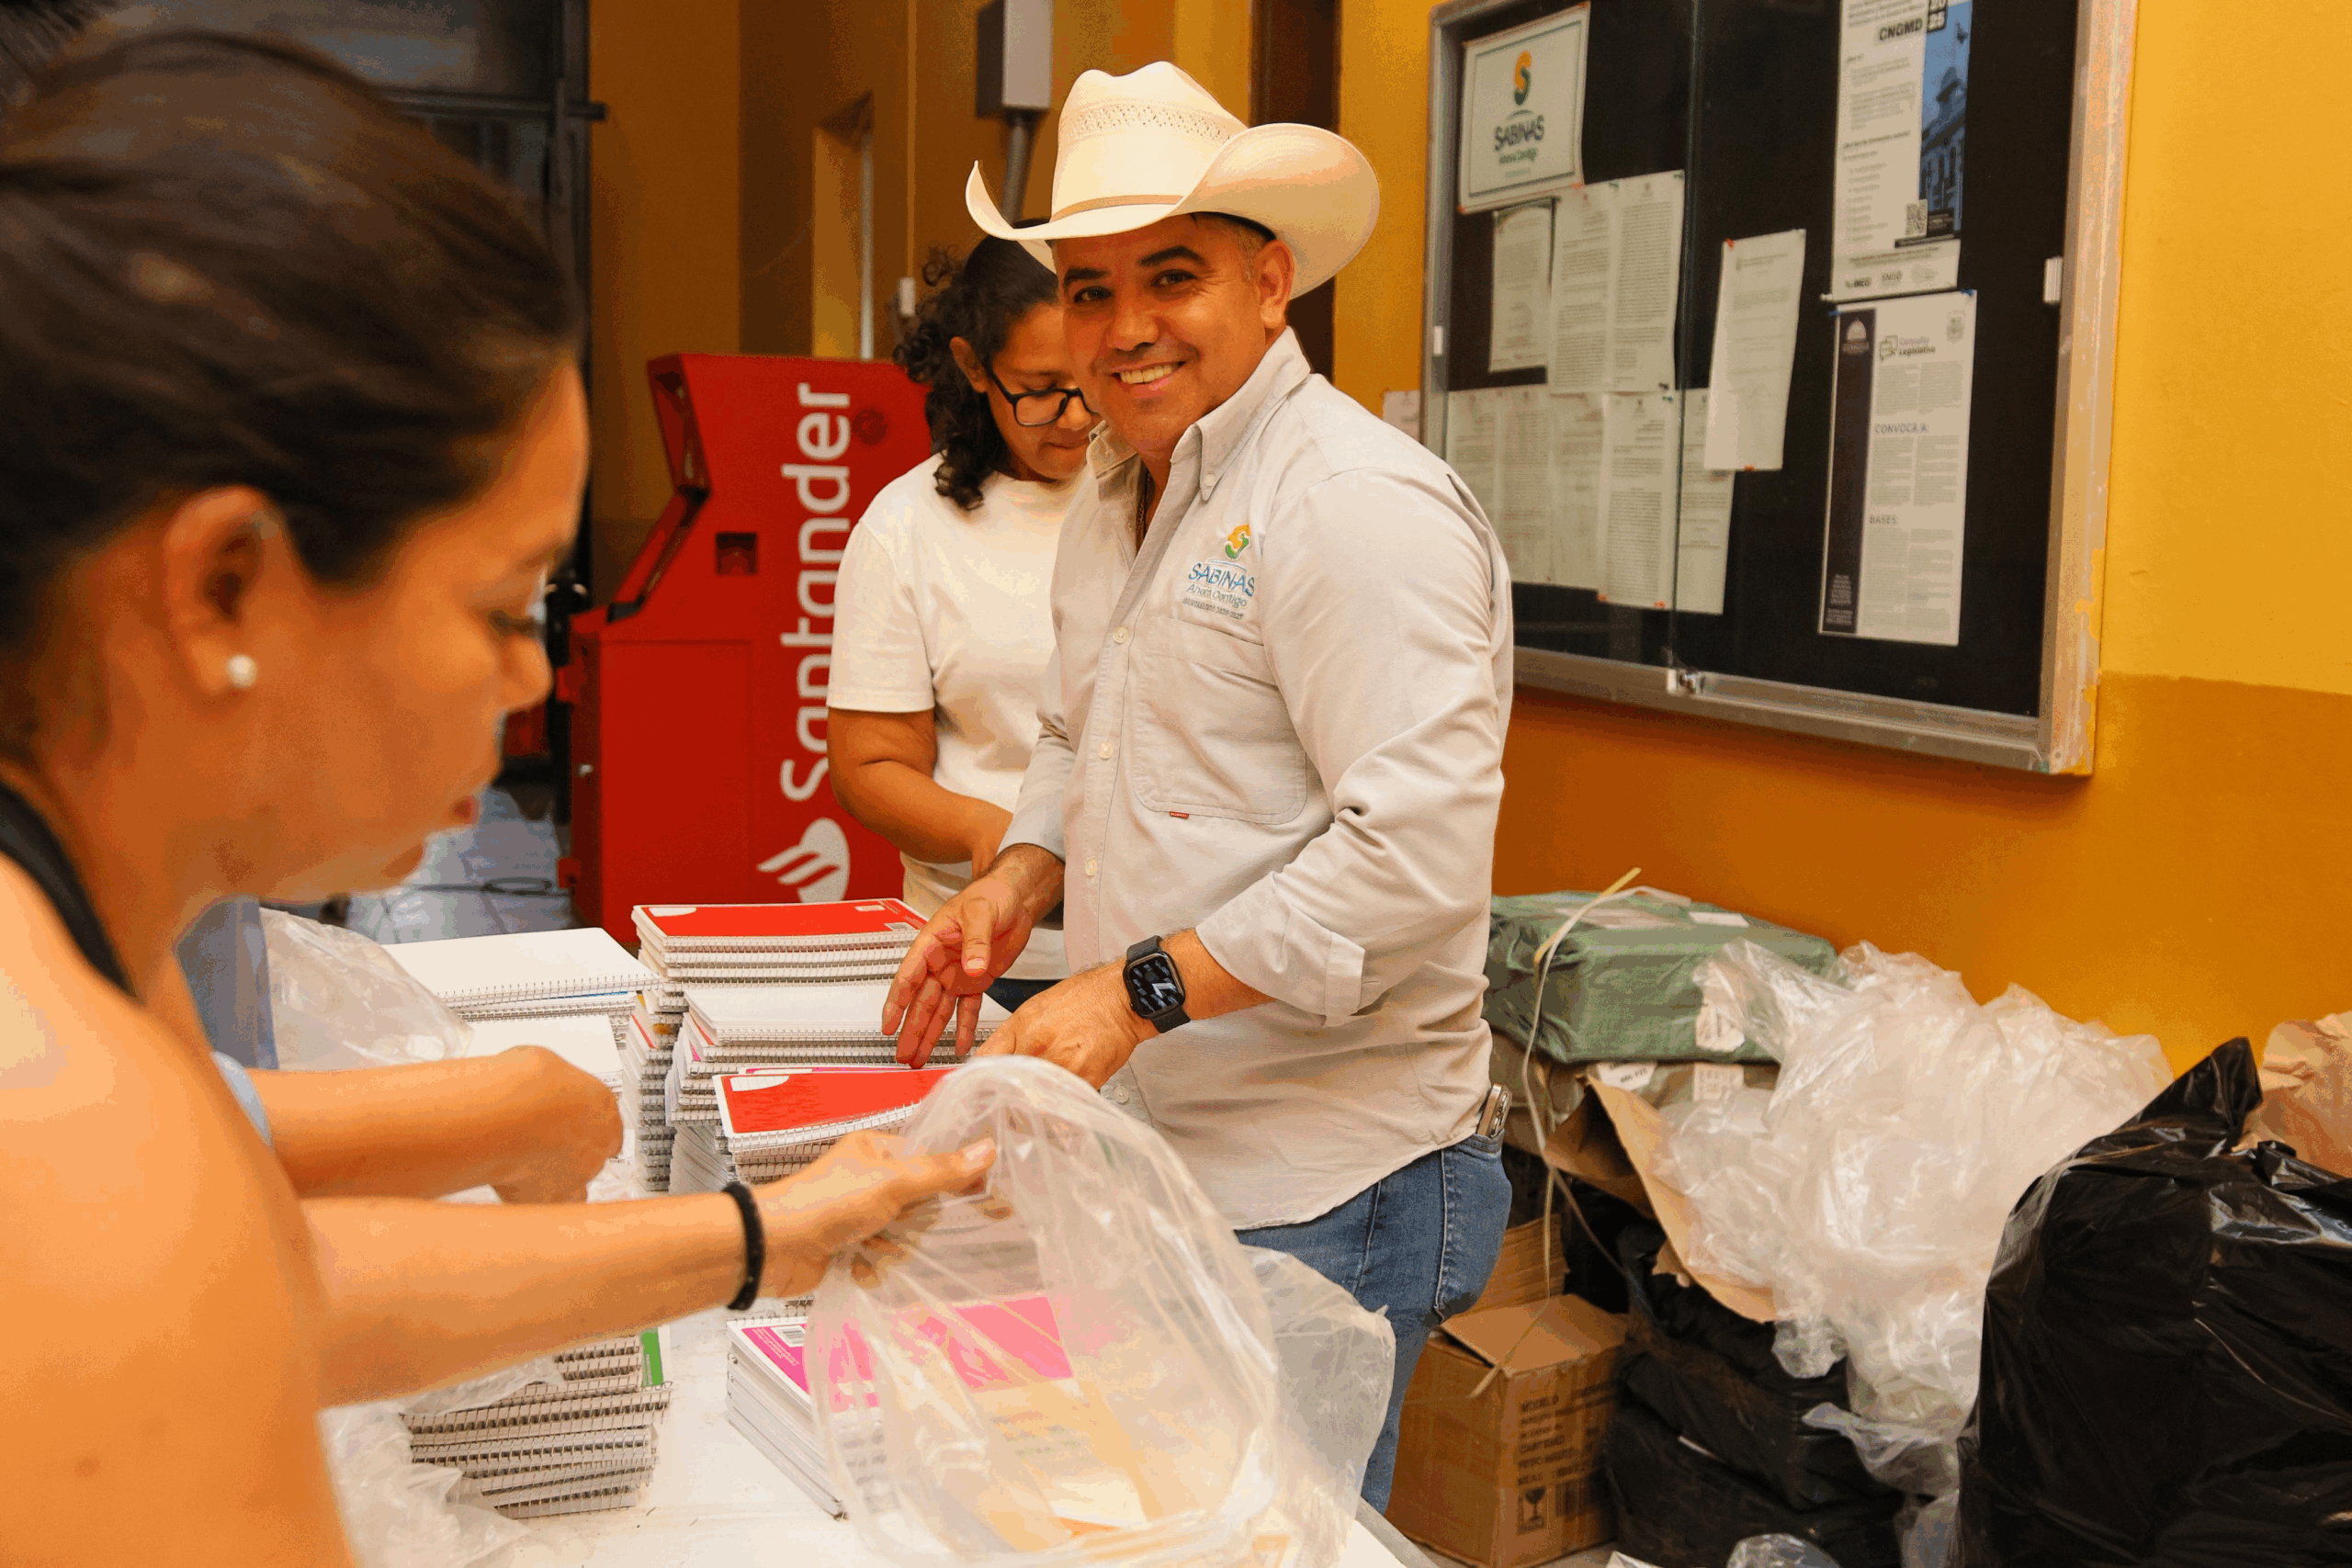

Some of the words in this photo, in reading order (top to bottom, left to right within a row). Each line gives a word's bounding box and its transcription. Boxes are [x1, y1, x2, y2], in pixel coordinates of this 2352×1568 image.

[1879, 17, 1923, 40] CNGMD
[1494, 115, 1544, 152] SABINAS
[1874, 423, 1918, 434] CONVOCA
[781, 382, 851, 801] Santander
[1189, 562, 1255, 597] SABINAS
[1213, 591, 1248, 608] Contigo
